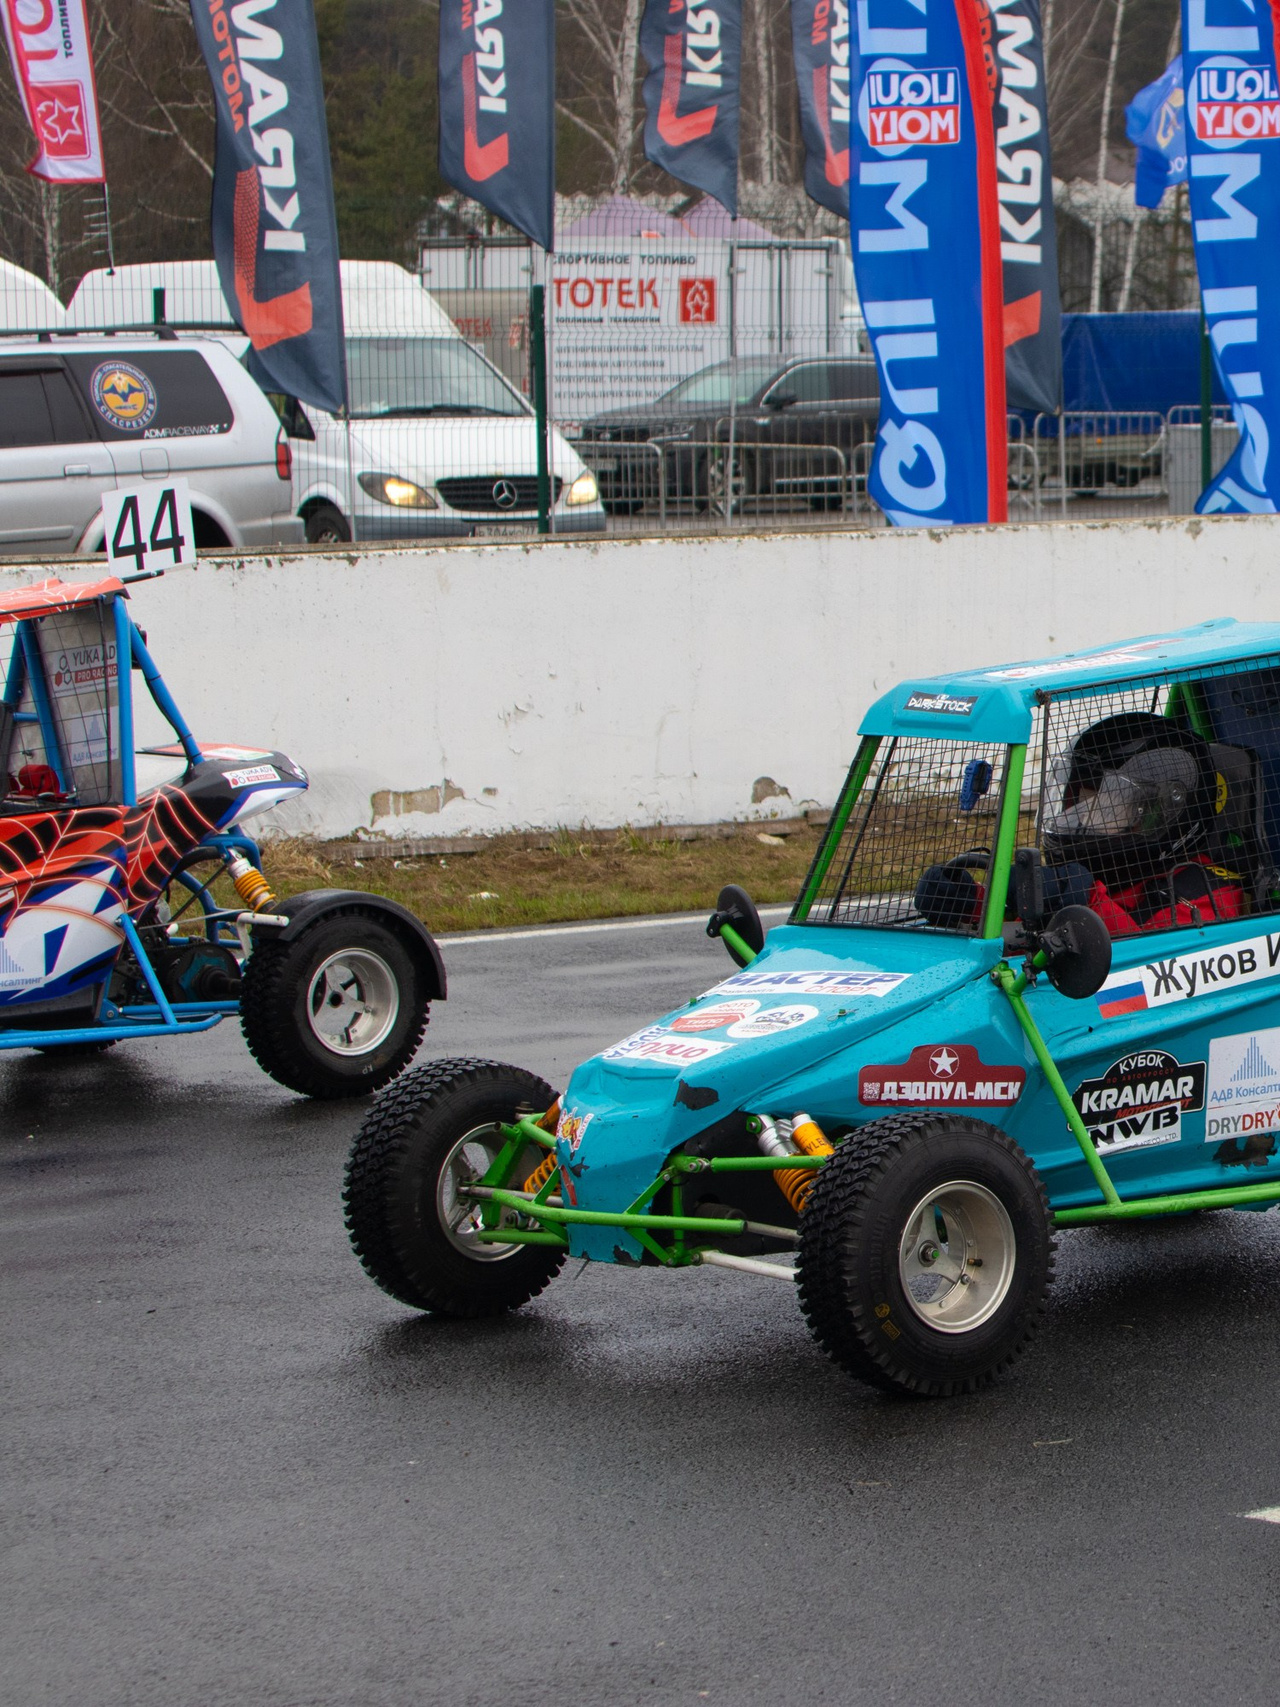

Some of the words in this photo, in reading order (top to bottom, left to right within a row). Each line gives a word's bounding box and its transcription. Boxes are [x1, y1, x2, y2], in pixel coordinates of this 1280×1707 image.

[641, 257, 696, 265] ТОПЛИВО
[553, 277, 659, 309] ТОТЕК
[112, 488, 185, 571] 44
[92, 665, 118, 678] RACNG
[1146, 957, 1257, 998] Жуков
[1120, 1054, 1165, 1075] КУБОК
[881, 1082, 1021, 1101] ДЭДПУЛ-МСК
[1081, 1076, 1195, 1114] KRAMAR
[1211, 1088, 1233, 1103] АДВ
[1090, 1105, 1179, 1148] NWB
[1208, 1110, 1275, 1136] DRYDRY
